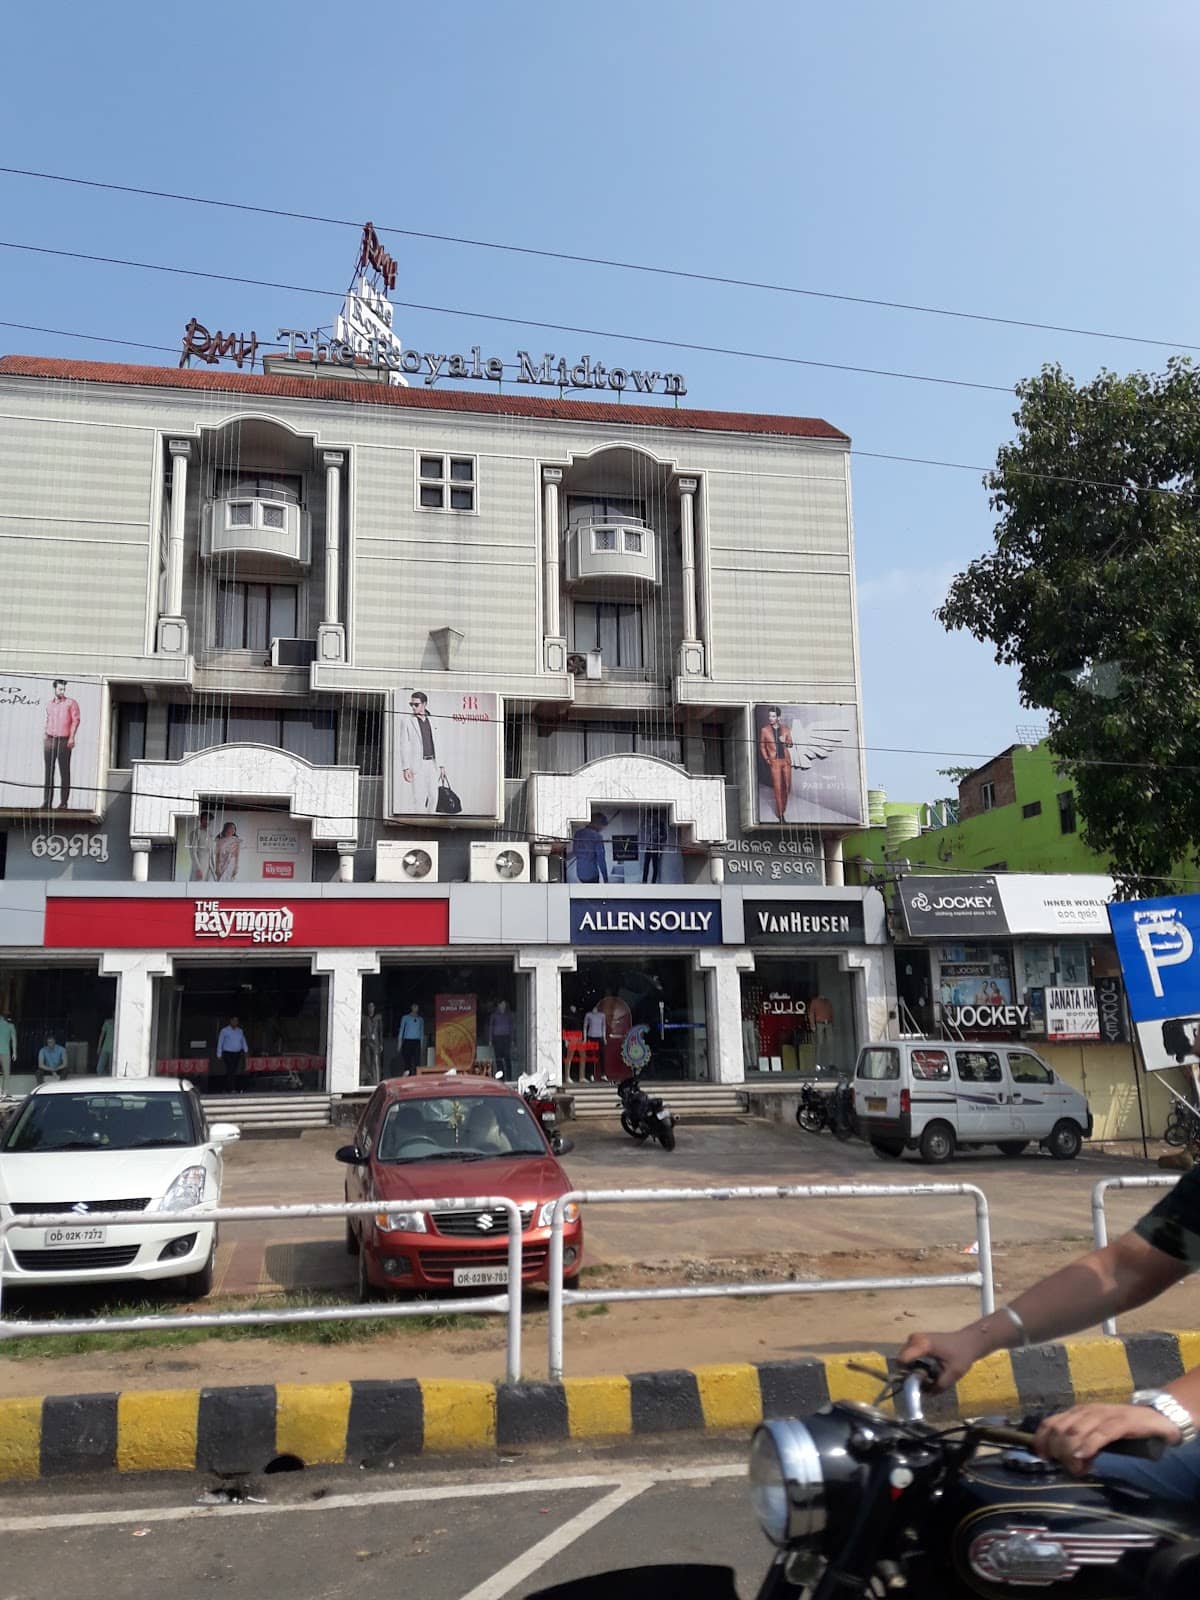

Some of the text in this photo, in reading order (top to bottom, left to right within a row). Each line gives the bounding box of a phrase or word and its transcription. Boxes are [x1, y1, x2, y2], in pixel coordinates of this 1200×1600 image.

[276, 328, 354, 366] The
[369, 337, 504, 384] Royale
[517, 350, 688, 396] Midtown
[195, 901, 219, 911] THE
[932, 896, 993, 909] JOCKEY
[1043, 899, 1106, 907] INNER WORLD
[579, 910, 713, 931] ALLEN SOLLY
[253, 931, 293, 943] SHOP
[1050, 989, 1081, 1010] JANATA
[947, 1005, 1028, 1027] JOCKEY
[1101, 982, 1120, 1041] JOCKEY
